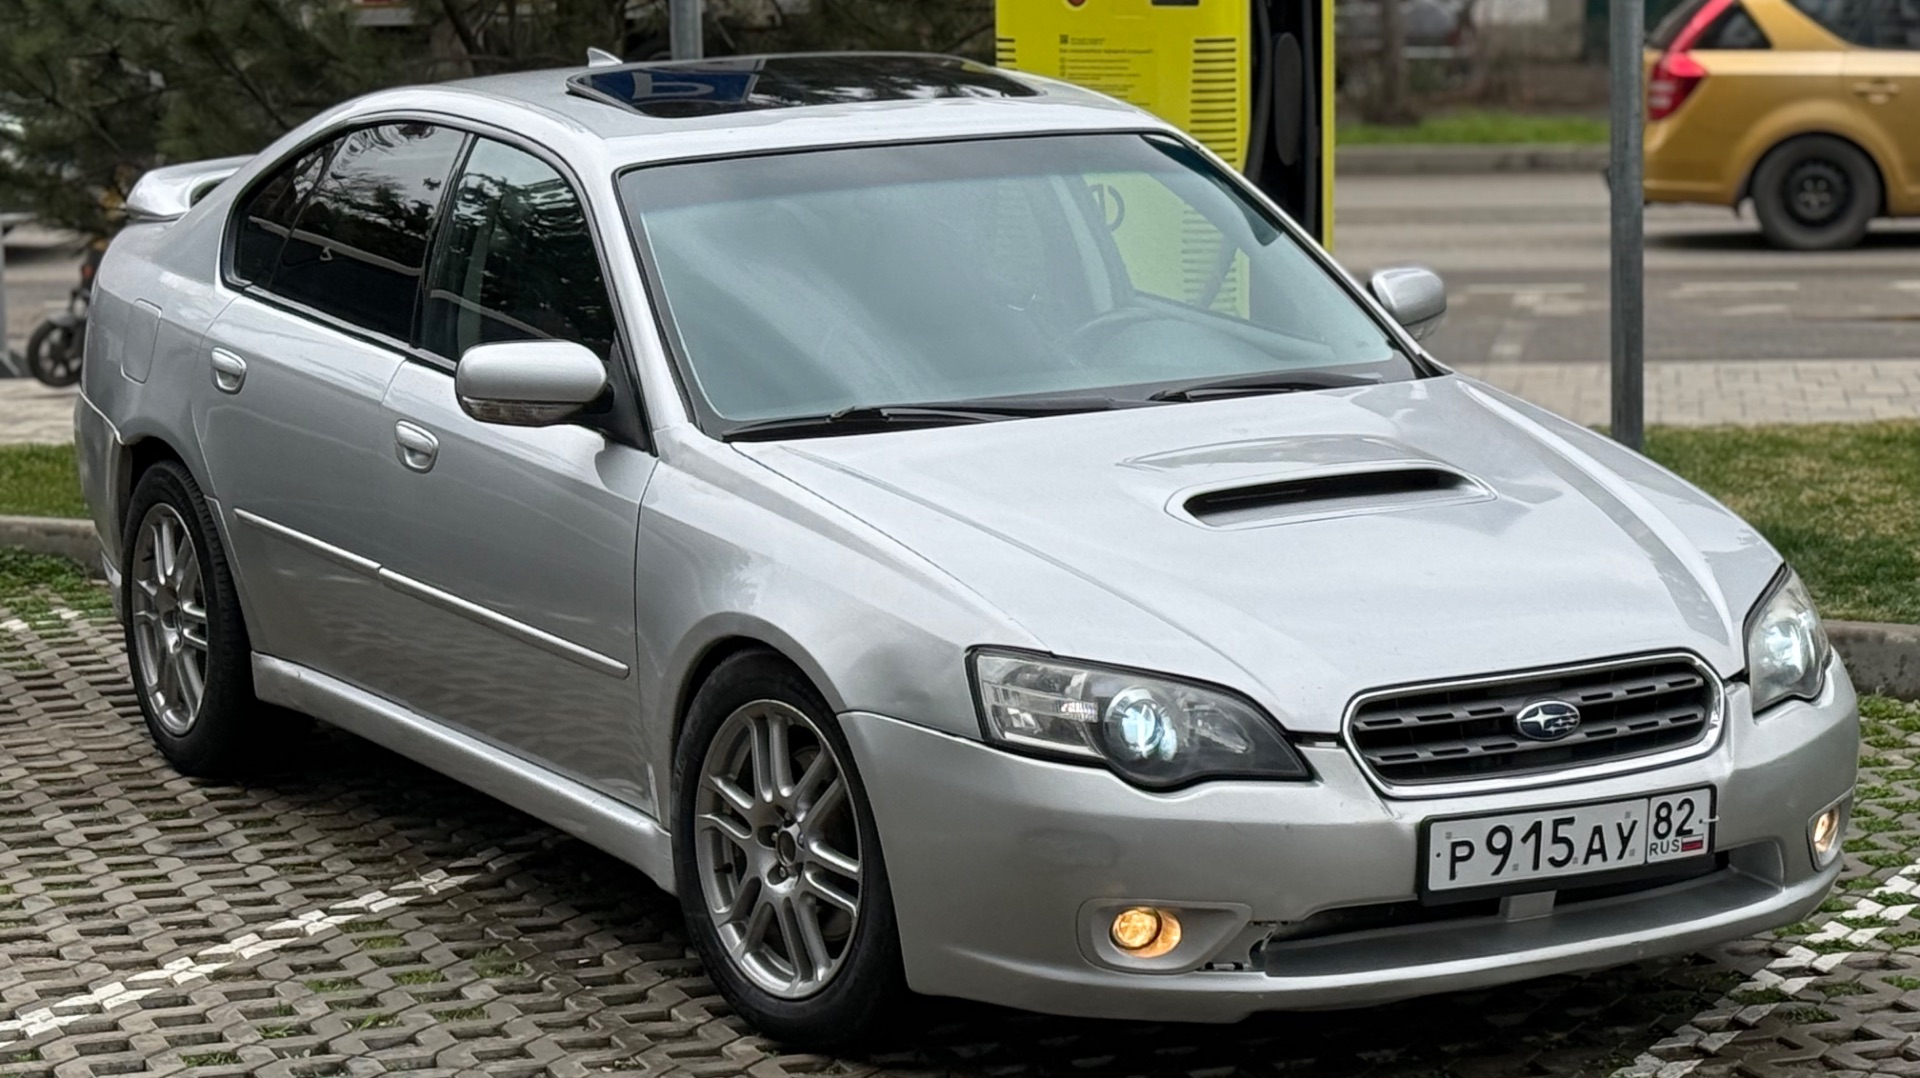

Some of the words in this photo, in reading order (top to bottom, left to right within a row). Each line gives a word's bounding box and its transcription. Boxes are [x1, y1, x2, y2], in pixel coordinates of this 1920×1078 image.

[1449, 816, 1637, 881] Р915АУ
[1653, 798, 1695, 840] 82
[1649, 839, 1681, 856] RUS
